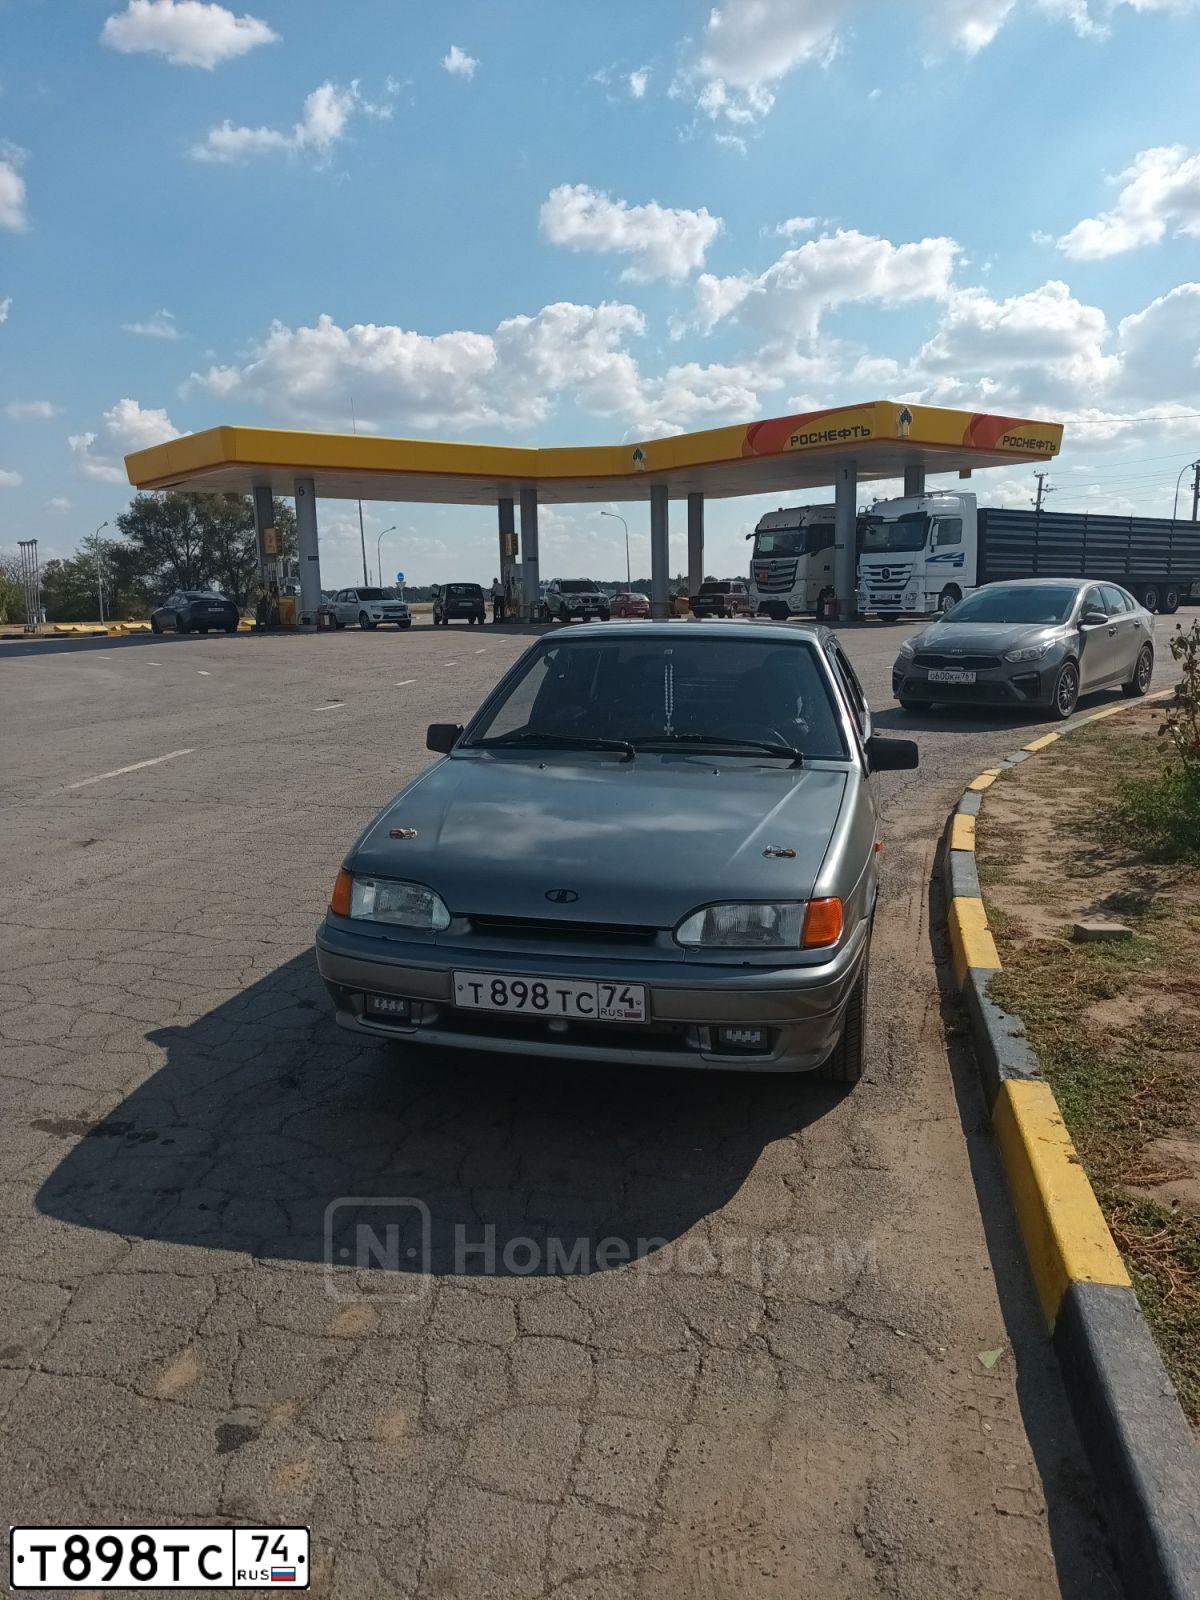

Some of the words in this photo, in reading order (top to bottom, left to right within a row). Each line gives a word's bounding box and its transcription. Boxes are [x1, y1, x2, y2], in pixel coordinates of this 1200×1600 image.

[790, 426, 871, 447] РОСНЕФТЬ
[1002, 435, 1056, 451] РОСНЕФТЬ
[298, 486, 305, 496] 6
[602, 985, 634, 1009] 74
[601, 1007, 623, 1018] RUS
